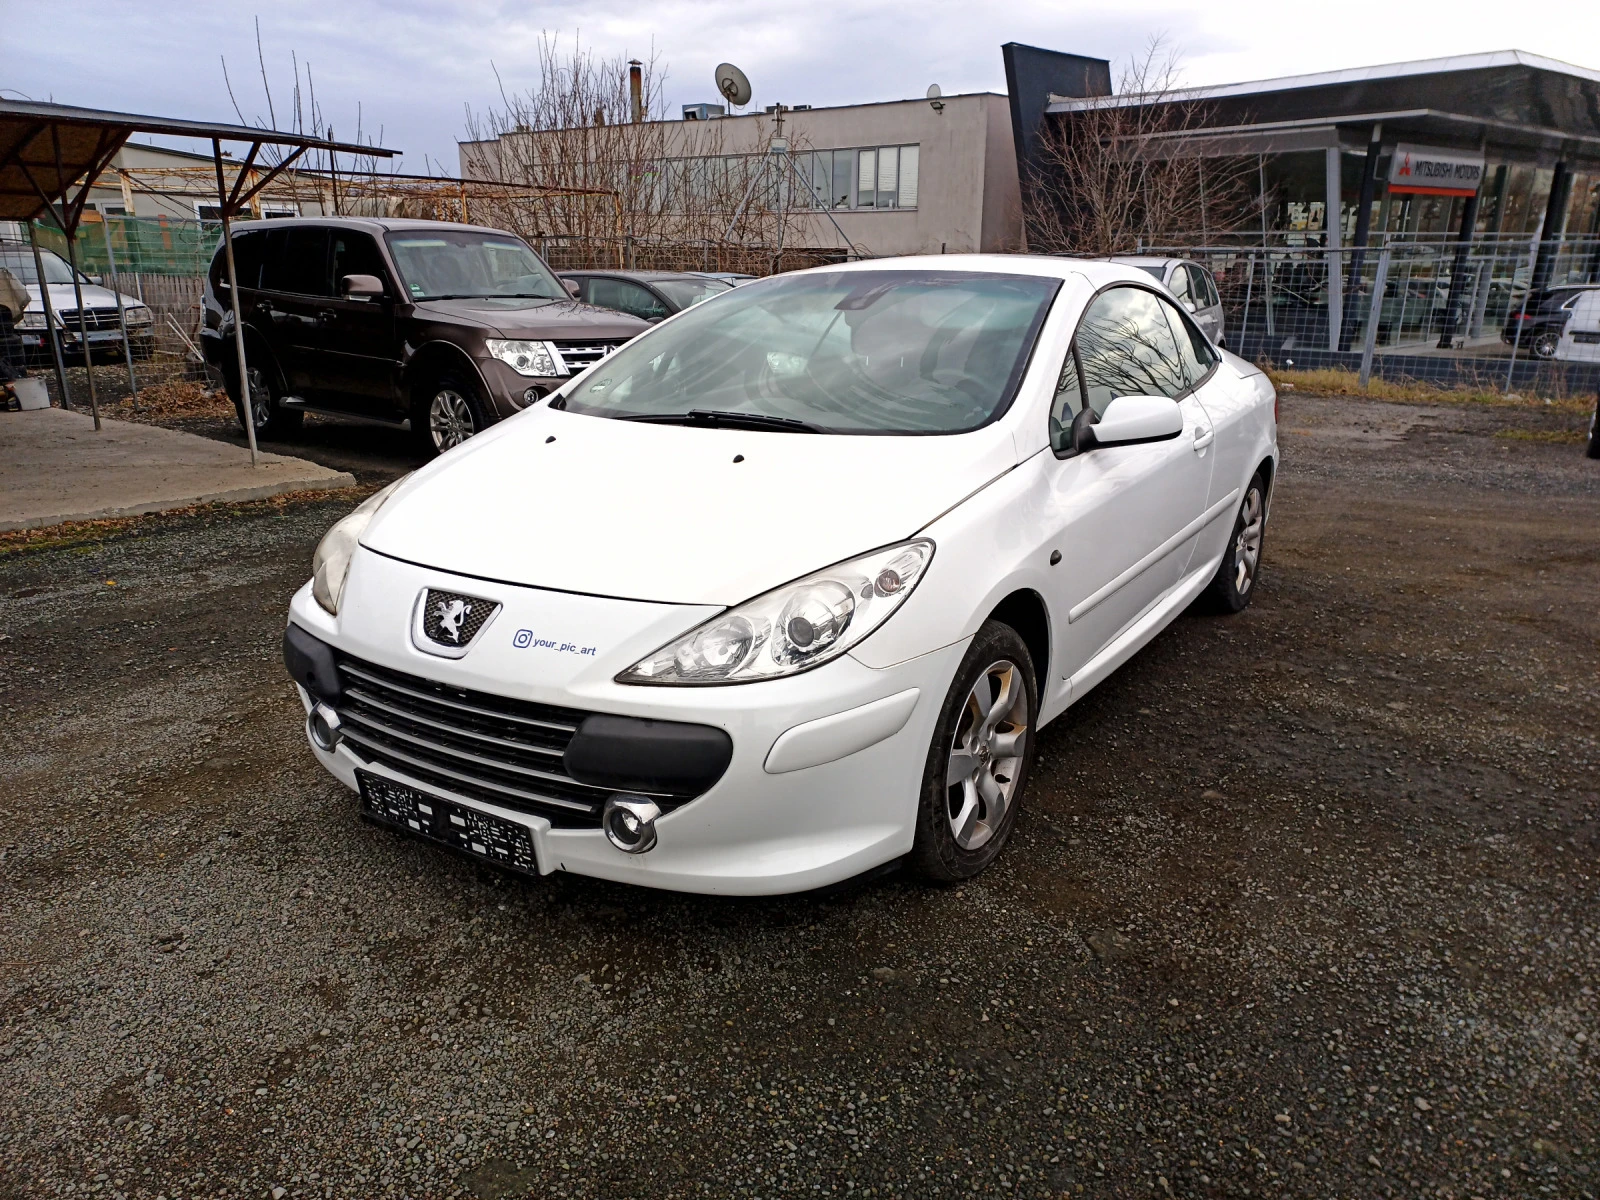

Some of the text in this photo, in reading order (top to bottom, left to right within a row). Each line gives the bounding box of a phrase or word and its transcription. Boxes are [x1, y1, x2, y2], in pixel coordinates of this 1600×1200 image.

[1414, 160, 1480, 180] MITSUBISHI MOTORS
[533, 638, 597, 656] your_pic_art
